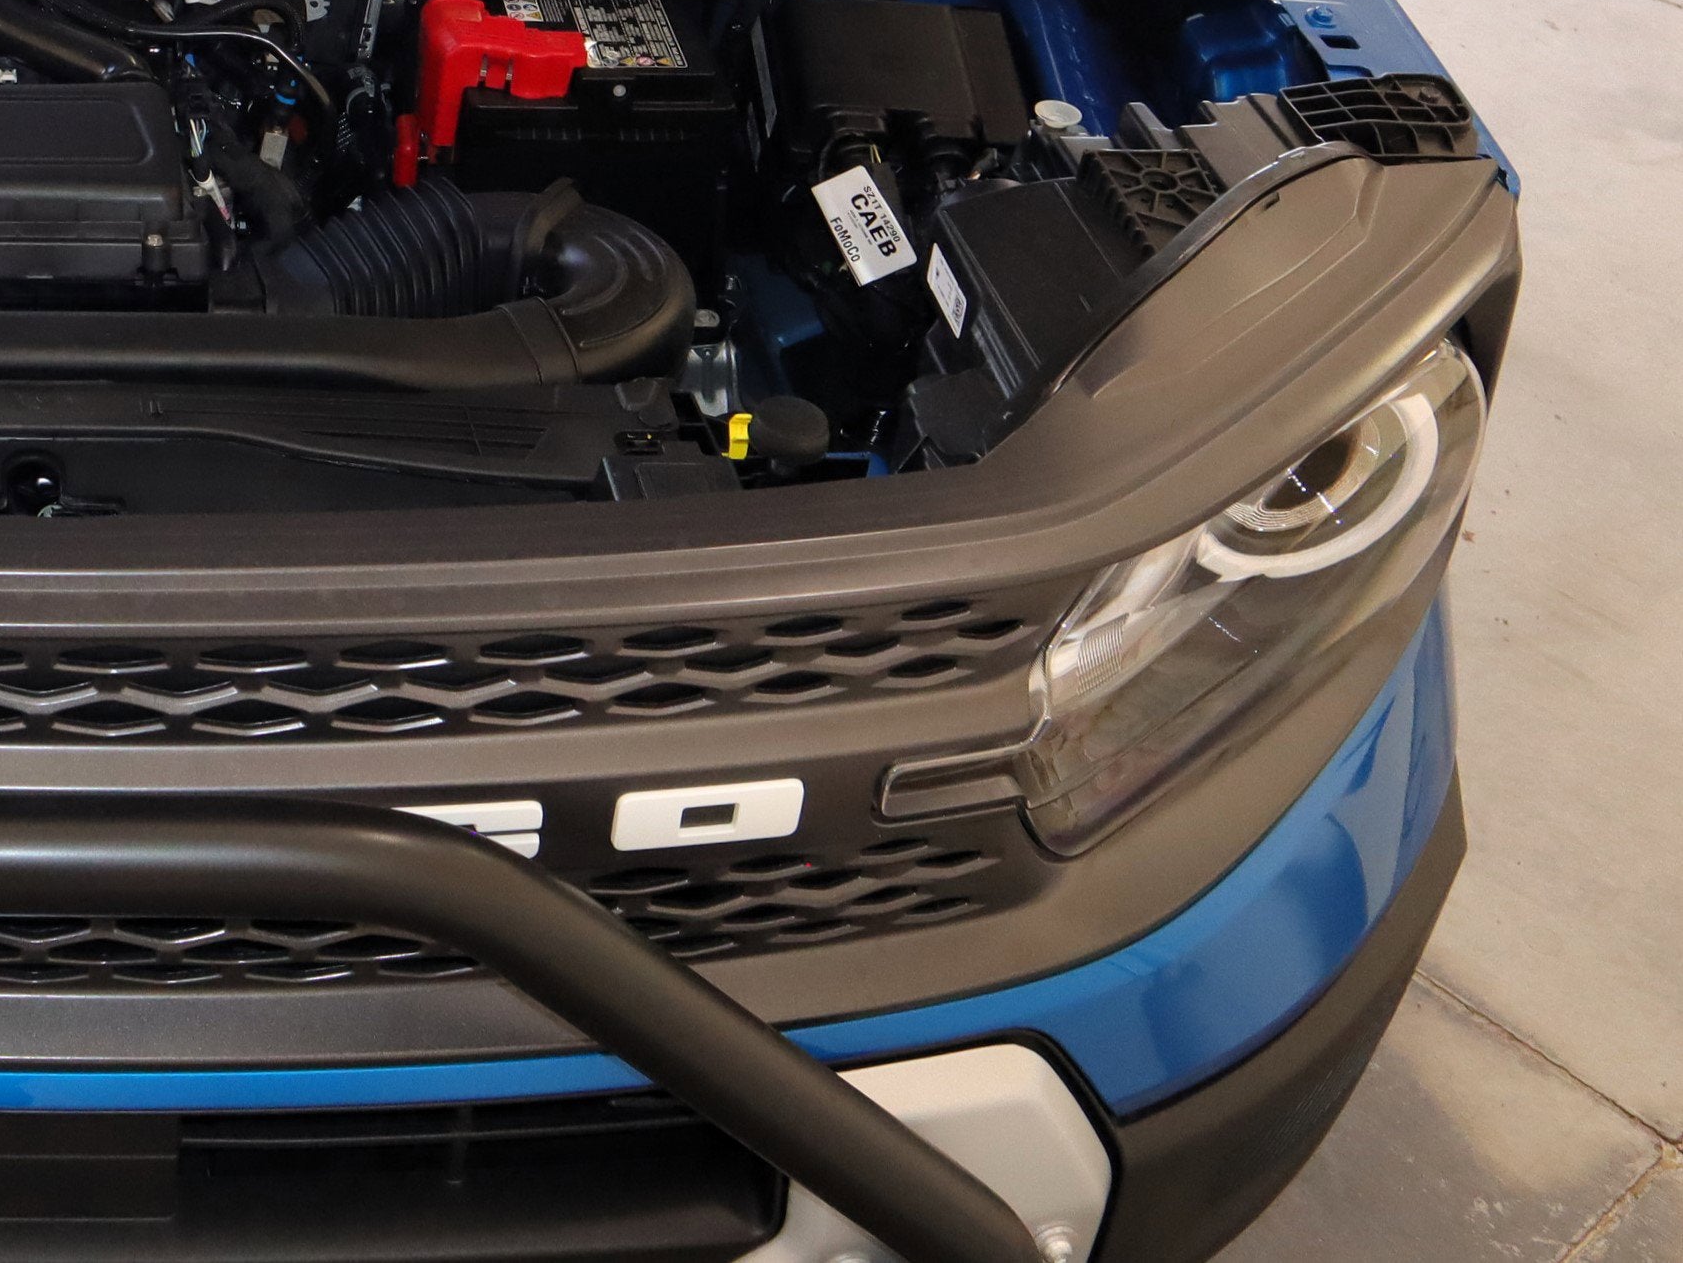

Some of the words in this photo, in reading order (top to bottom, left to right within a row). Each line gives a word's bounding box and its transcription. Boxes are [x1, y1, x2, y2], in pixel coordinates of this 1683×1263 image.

[830, 217, 861, 262] FoMoCo
[851, 193, 897, 257] CAEB
[864, 186, 882, 209] SZ1T
[880, 214, 901, 242] 14290
